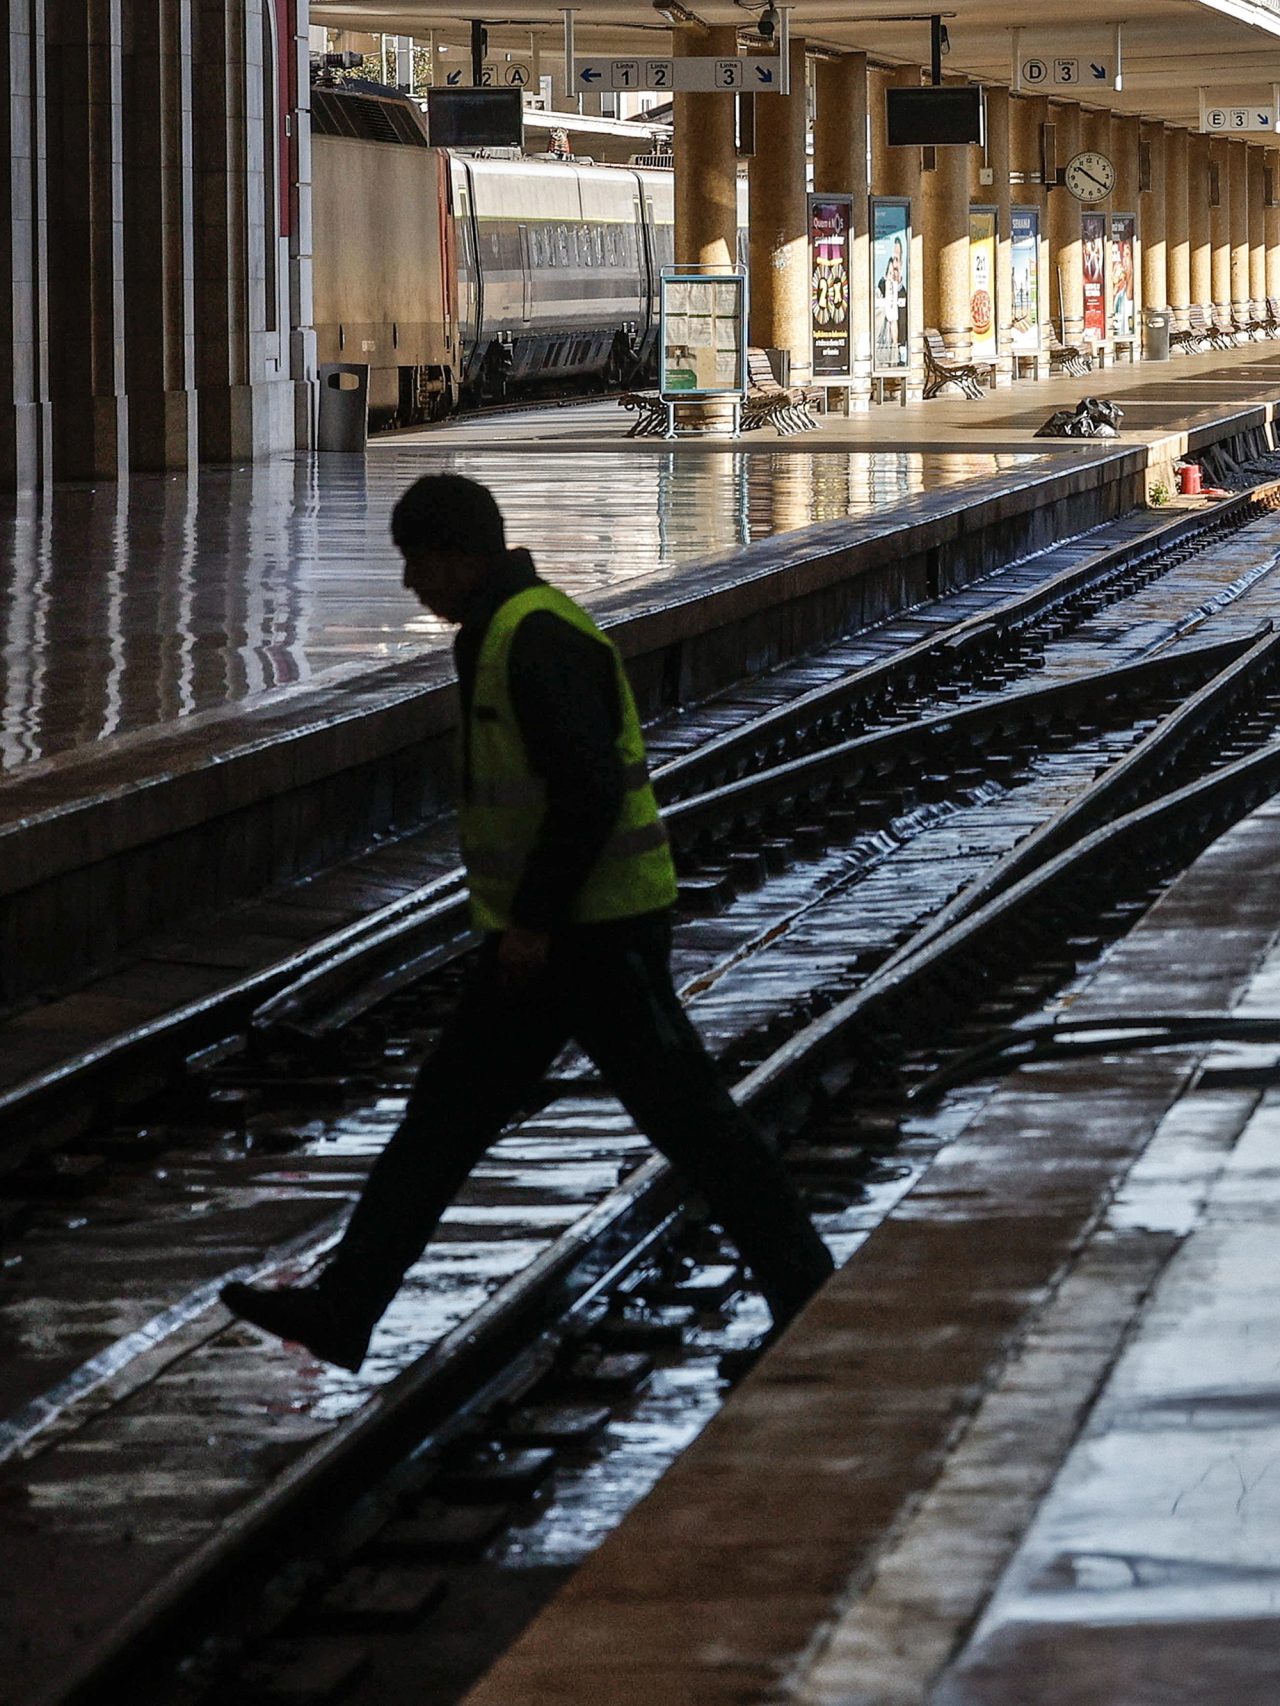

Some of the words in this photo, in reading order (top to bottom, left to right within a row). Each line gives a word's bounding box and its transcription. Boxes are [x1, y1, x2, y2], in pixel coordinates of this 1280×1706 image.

[482, 72, 491, 86] 2
[511, 69, 524, 83] A
[622, 70, 629, 85] 1
[655, 70, 666, 85] 2
[723, 69, 734, 85] 3
[1030, 65, 1041, 79] D
[1061, 66, 1071, 81] 3
[1213, 114, 1221, 125] E
[1236, 115, 1244, 126] 3
